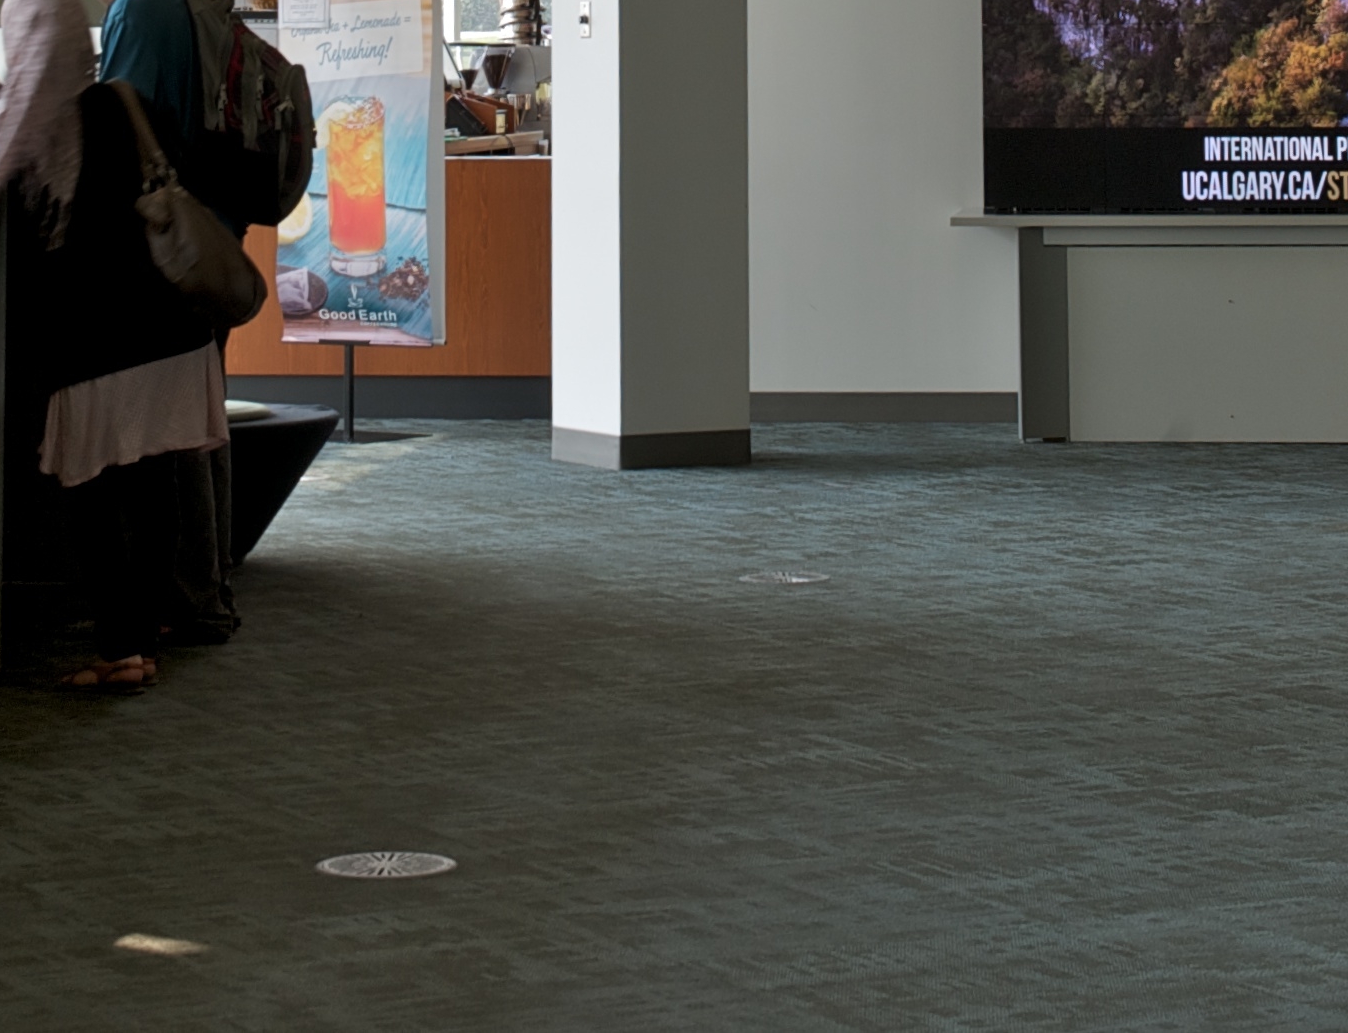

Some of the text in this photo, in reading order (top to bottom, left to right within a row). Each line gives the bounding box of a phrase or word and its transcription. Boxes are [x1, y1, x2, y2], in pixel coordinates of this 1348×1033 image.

[349, 10, 402, 33] Lemonade
[316, 36, 393, 70] Refreshing!
[1204, 135, 1333, 161] INTERNATIONAL
[318, 308, 397, 321] Good Earth
